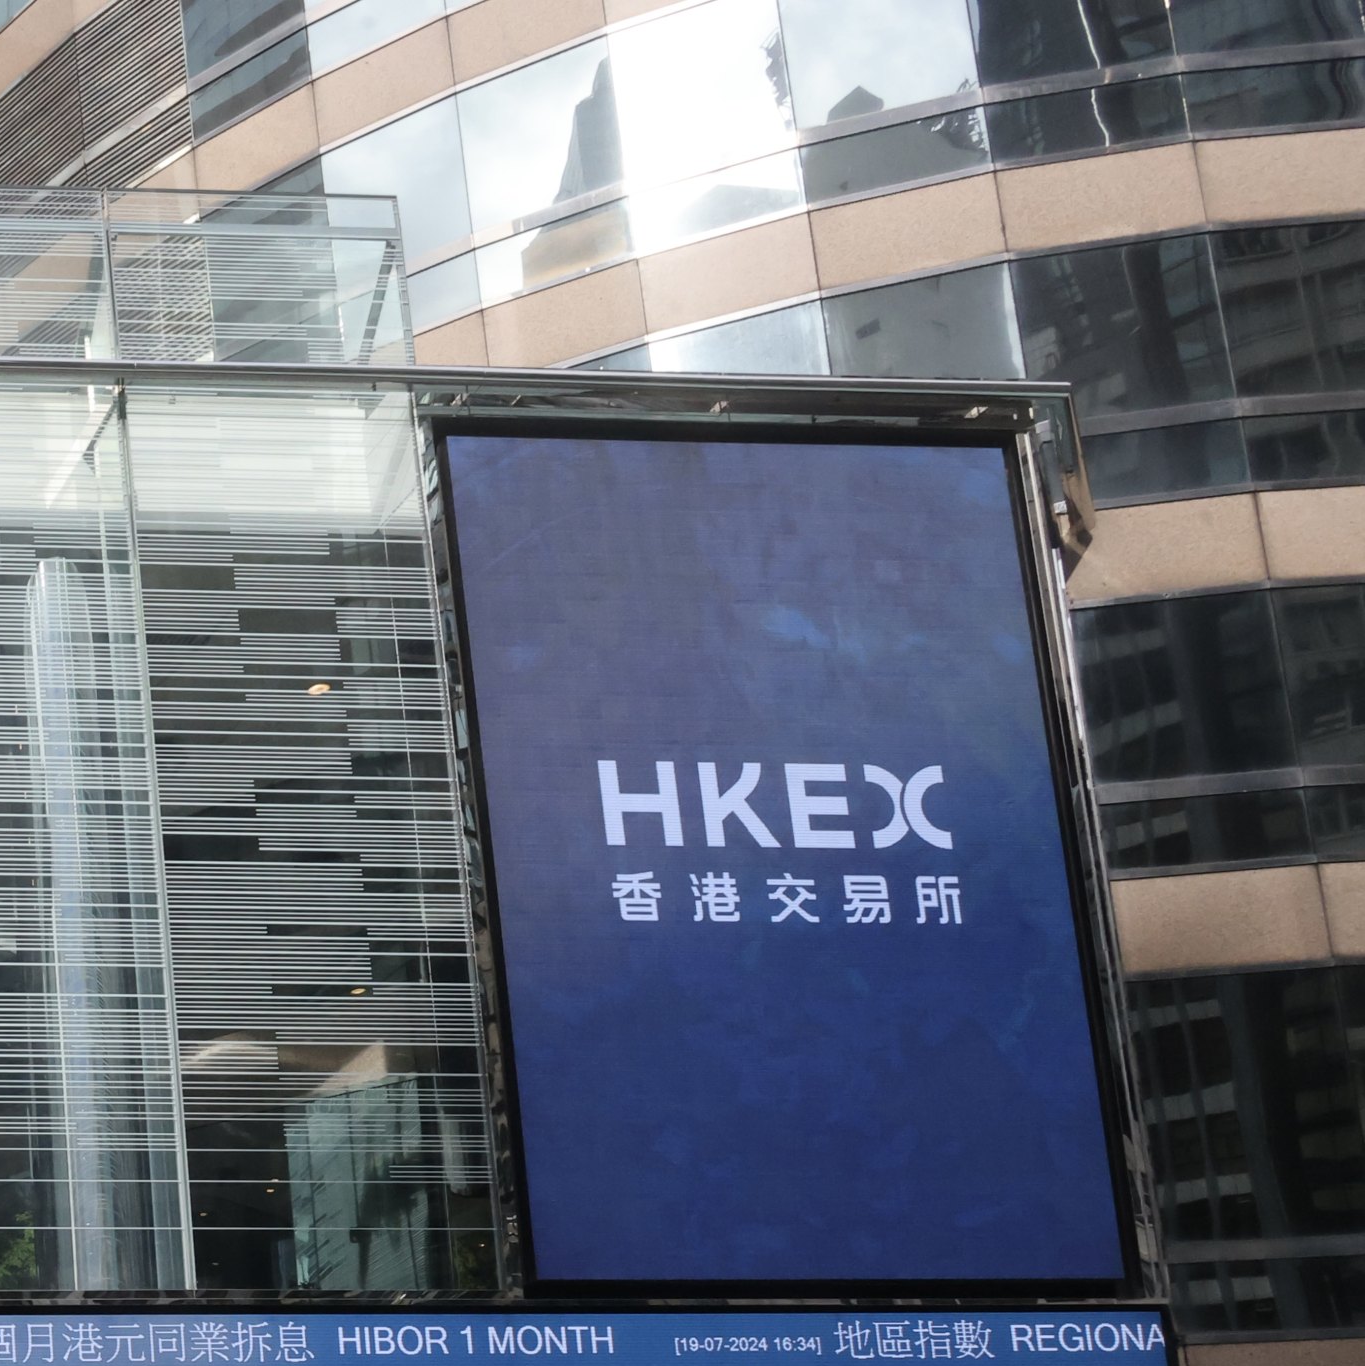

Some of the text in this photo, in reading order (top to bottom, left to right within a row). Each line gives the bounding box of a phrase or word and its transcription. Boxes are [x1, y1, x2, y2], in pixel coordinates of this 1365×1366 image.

[597, 760, 953, 849] HKEX
[611, 871, 962, 924] 香港交易所
[338, 1325, 449, 1355] HIBOR
[460, 1326, 473, 1354] 1
[488, 1325, 614, 1355] MONTH
[833, 1320, 995, 1360] 地區指數
